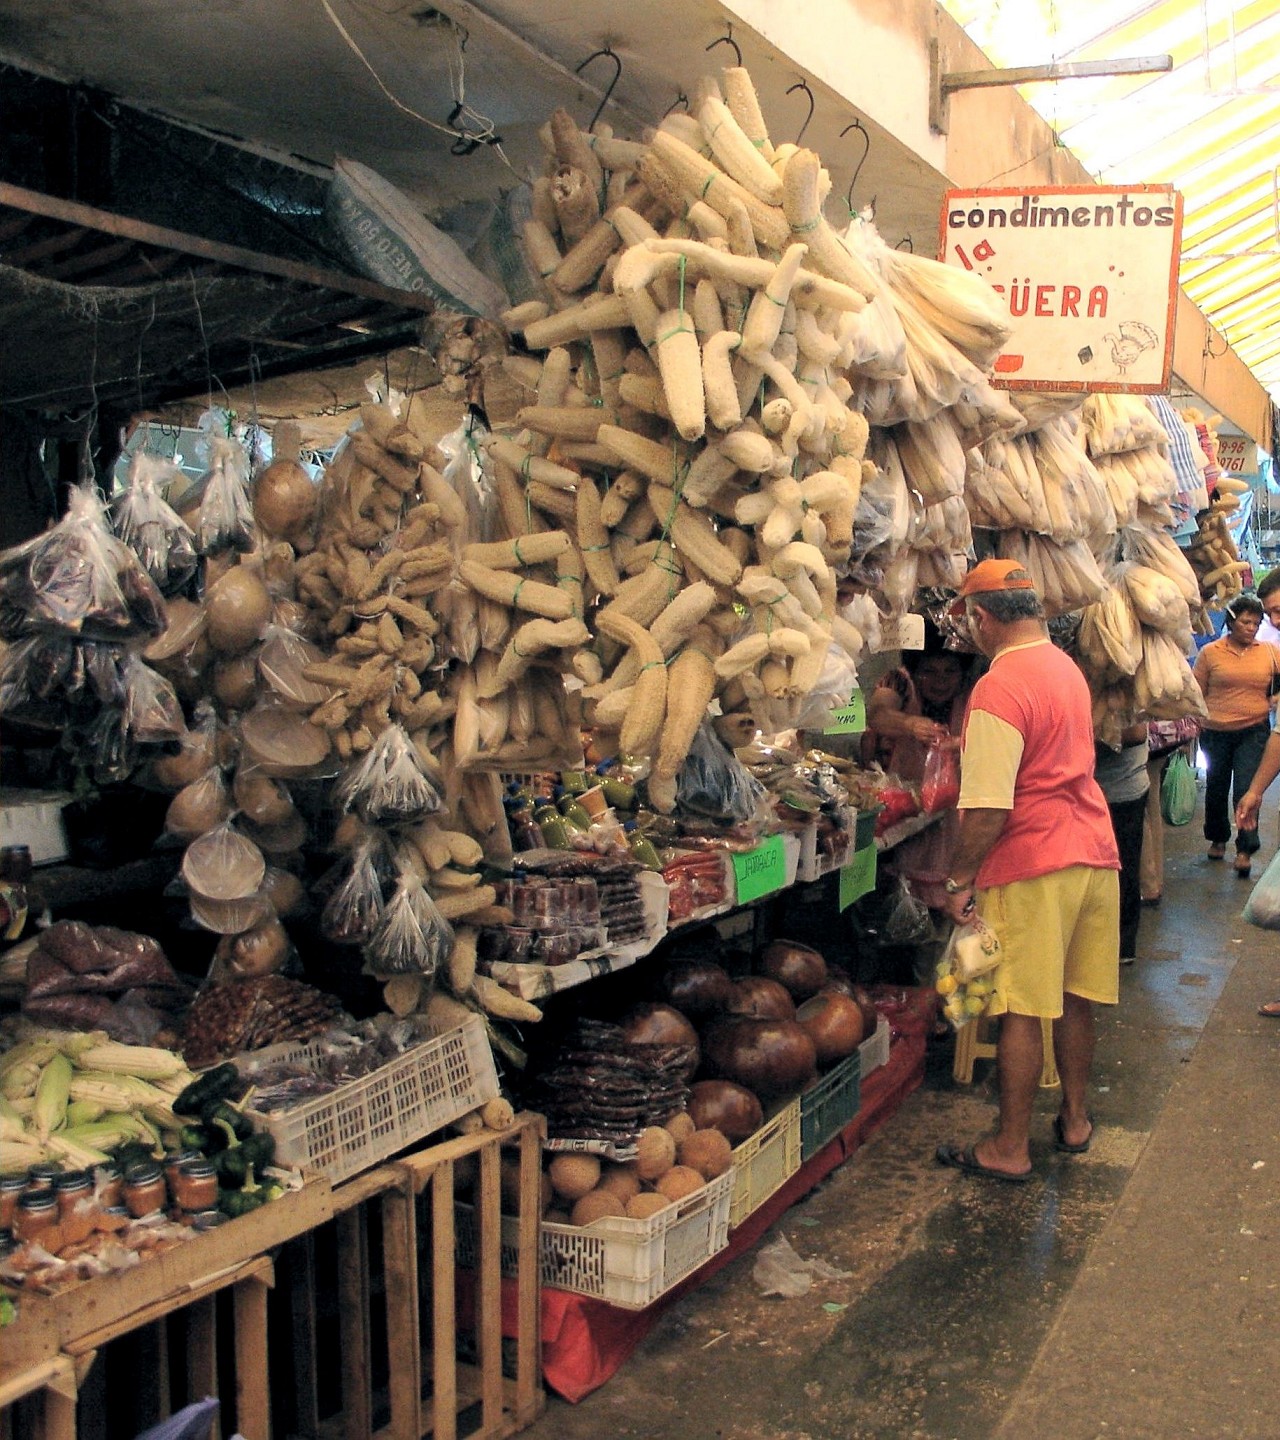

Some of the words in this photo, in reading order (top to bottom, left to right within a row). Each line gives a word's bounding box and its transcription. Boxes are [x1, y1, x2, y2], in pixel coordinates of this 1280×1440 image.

[948, 194, 1174, 229] condimentos
[954, 239, 996, 271] la
[991, 277, 1109, 318] ÜERA
